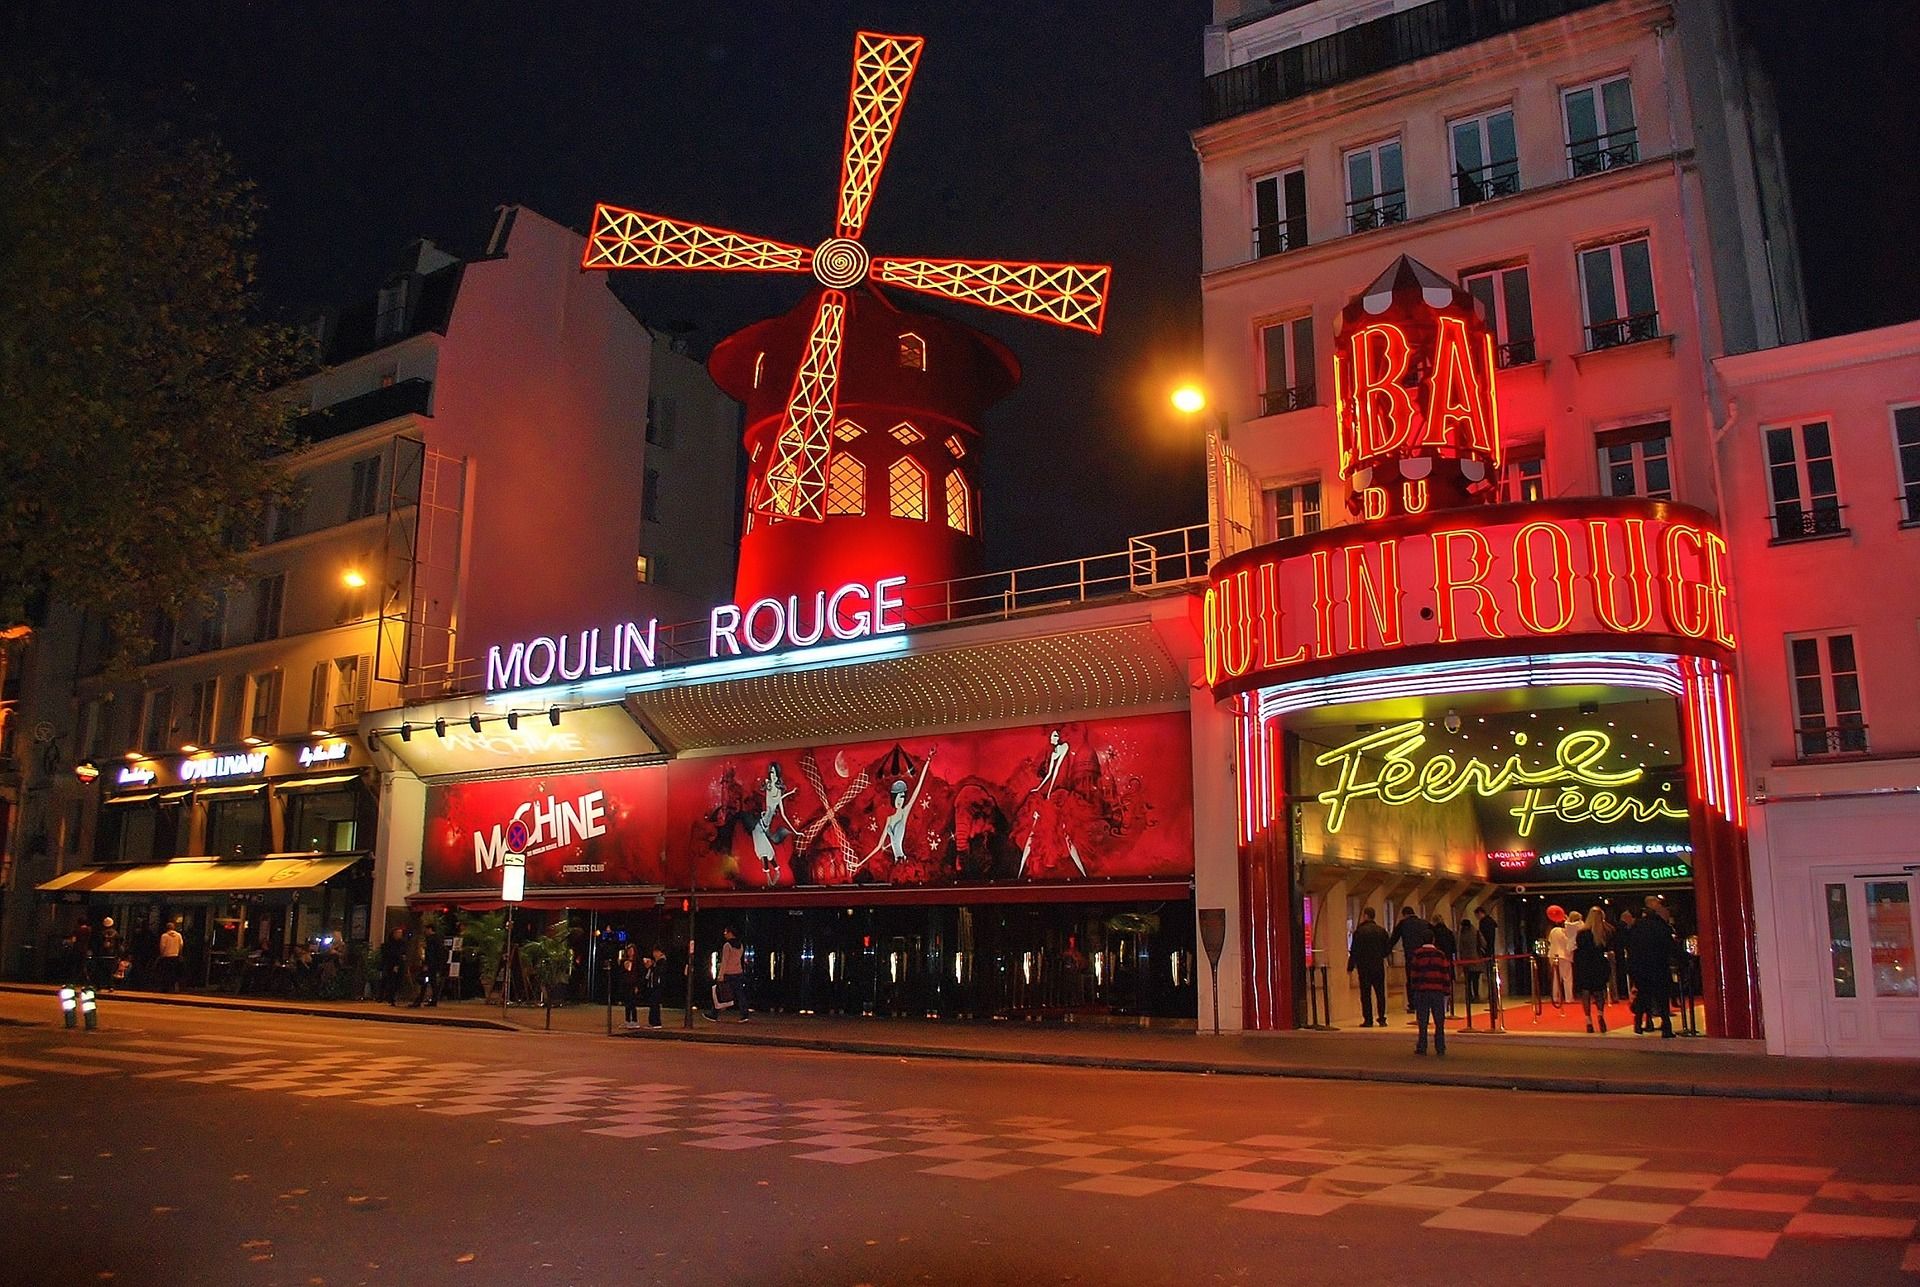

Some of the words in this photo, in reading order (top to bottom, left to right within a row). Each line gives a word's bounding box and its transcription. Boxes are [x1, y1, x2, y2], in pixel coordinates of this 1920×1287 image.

[1350, 317, 1500, 469] BA
[1363, 480, 1428, 520] DU
[487, 617, 658, 691] MOULIN
[709, 575, 908, 658] ROUGE
[1203, 540, 1403, 688] OULIN
[1432, 519, 1736, 649] ROUGE
[1509, 782, 1691, 838] Féeri
[1577, 868, 1600, 880] LES
[1602, 868, 1650, 881] DORISS
[1650, 864, 1689, 880] GIRLS
